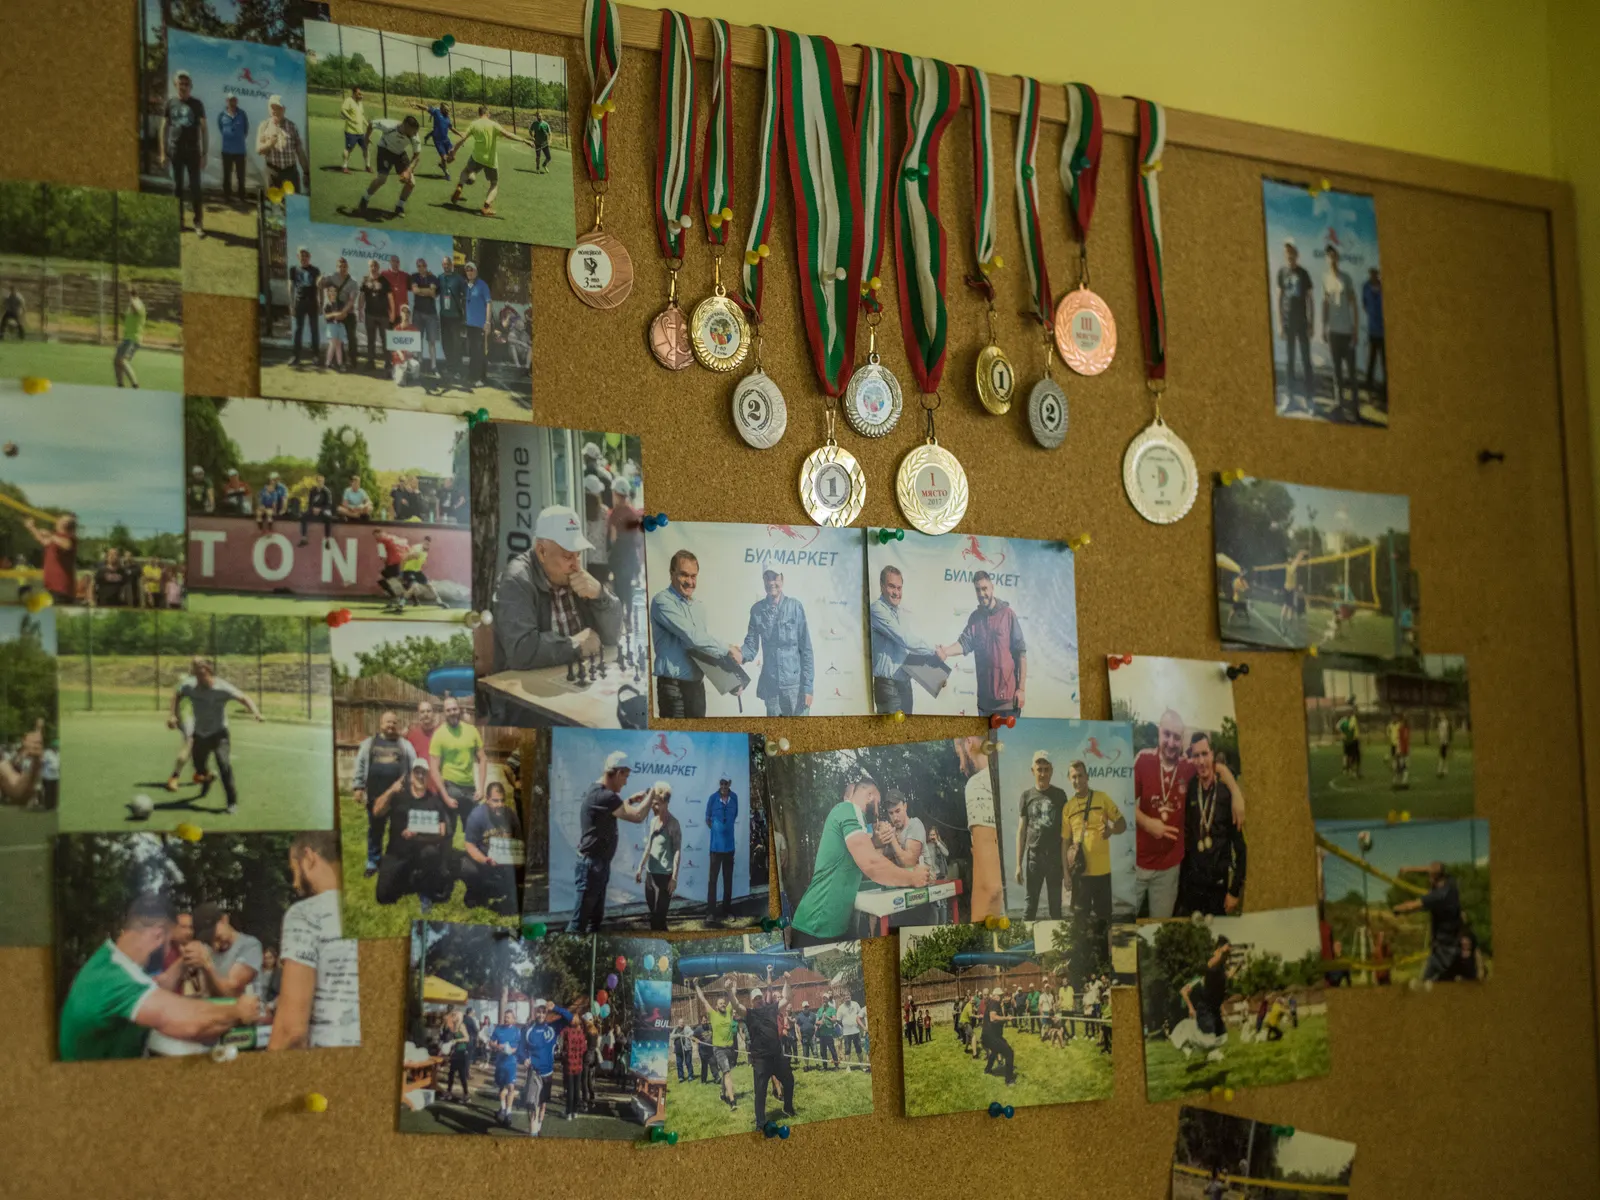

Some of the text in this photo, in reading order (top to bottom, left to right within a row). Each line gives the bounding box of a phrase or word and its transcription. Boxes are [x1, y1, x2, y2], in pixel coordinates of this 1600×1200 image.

[223, 84, 271, 99] БУЛМАРК
[997, 370, 1006, 390] 1
[747, 399, 762, 421] 2
[1045, 402, 1056, 423] 2
[825, 476, 841, 497] 1
[921, 488, 948, 498] МЯСТО
[927, 498, 943, 506] 2017
[744, 547, 839, 567] БУЛМАРКЕТ
[943, 568, 1021, 588] БУЛМРКЕТ
[633, 761, 697, 777] БУЛМАРКЕТ
